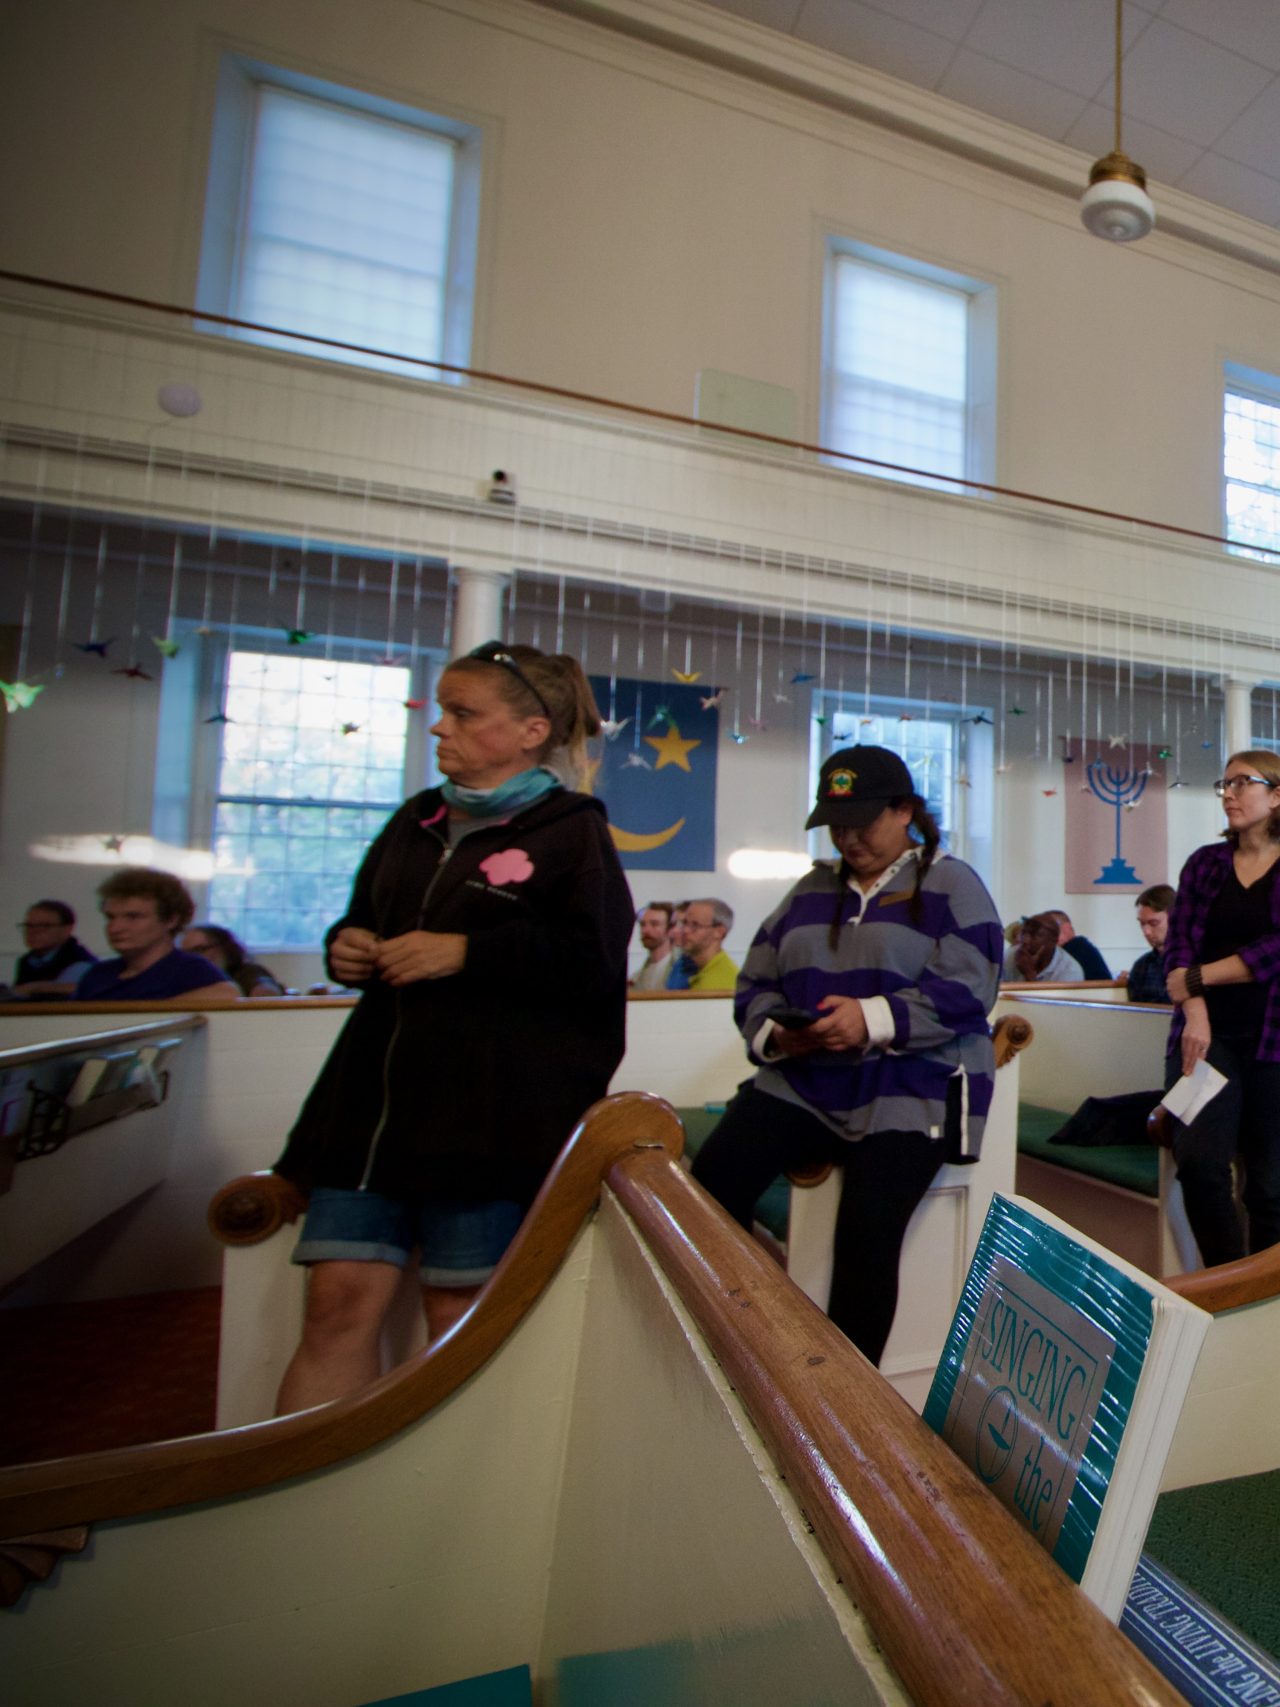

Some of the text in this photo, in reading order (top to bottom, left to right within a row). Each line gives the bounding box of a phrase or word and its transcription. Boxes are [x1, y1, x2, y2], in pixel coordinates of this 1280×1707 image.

[981, 1300, 1087, 1440] SINGING
[1014, 1436, 1052, 1531] the
[1160, 1614, 1227, 1660] LIVING
[1209, 1652, 1247, 1675] the
